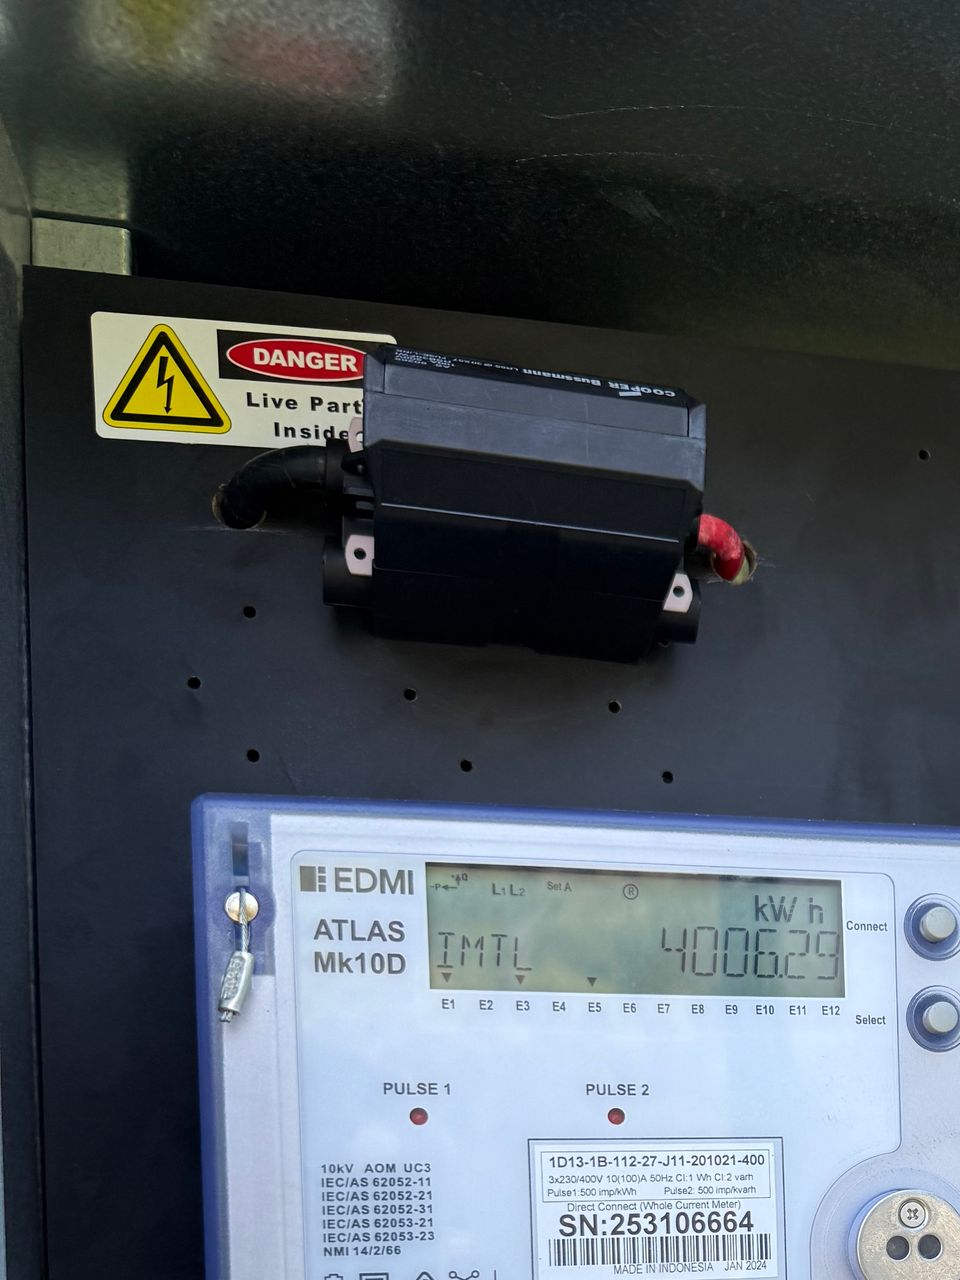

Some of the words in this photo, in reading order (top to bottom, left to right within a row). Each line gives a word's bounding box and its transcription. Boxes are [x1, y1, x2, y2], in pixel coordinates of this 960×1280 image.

[253, 347, 359, 373] DANGER
[522, 368, 601, 387] Bussmann
[608, 381, 677, 398] COOPER
[246, 391, 298, 410] Live
[273, 421, 349, 441] Inside
[334, 867, 414, 895] EDMI
[313, 918, 406, 942] ATLAS
[846, 920, 888, 932] Connect
[662, 925, 841, 981] 4006.29
[314, 951, 406, 975] Mk10D
[441, 998, 456, 1010] E1
[479, 999, 493, 1011] E2
[516, 1000, 530, 1012] E3
[552, 1000, 566, 1012] E4
[588, 1001, 602, 1013] E5
[623, 1002, 637, 1014] E6
[657, 1003, 670, 1014] E7
[691, 1003, 705, 1015] E8
[725, 1004, 738, 1015] E9
[755, 1004, 775, 1016] E10
[789, 1005, 807, 1016] E11
[821, 1005, 841, 1017] E12
[855, 1014, 886, 1026] Select
[383, 1082, 439, 1096] PULSE
[444, 1082, 451, 1095] 1
[586, 1083, 637, 1096] PULSE
[641, 1083, 650, 1096] 2
[321, 1163, 354, 1174] 10kV
[364, 1163, 397, 1174] AOM
[403, 1162, 432, 1174] UC3
[549, 1154, 765, 1168] 1D13-1B-112-27-J11-201021-400
[321, 1177, 369, 1188] IEC/AS
[372, 1176, 431, 1187] 62052-11
[548, 1174, 603, 1184] 3x230/400V
[607, 1174, 648, 1184] 10(100)A
[650, 1173, 673, 1183] 50Hz
[696, 1173, 711, 1182] Wh
[321, 1191, 369, 1202] IEC/AS
[373, 1190, 433, 1201] 62052-21
[698, 1186, 714, 1195] 500
[322, 1205, 370, 1216] IEC/AS
[374, 1204, 433, 1215] 62052-31
[567, 1203, 595, 1212] Direct
[597, 1202, 637, 1212] Connect
[639, 1201, 673, 1211] (Whole
[675, 1201, 709, 1210] Current
[712, 1200, 741, 1210] Meter)
[322, 1219, 371, 1229] IEC/AS
[374, 1218, 433, 1228] 62053-21
[559, 1210, 754, 1237] SN:253106664
[323, 1232, 371, 1243] IEC/AS
[374, 1231, 435, 1242] 62053-23
[323, 1246, 349, 1257] NMI
[353, 1245, 402, 1256] 14/2/66
[613, 1264, 643, 1275] MADE
[646, 1264, 657, 1274] IN
[659, 1262, 714, 1274] INDONESIA
[724, 1261, 743, 1271] JAN
[745, 1260, 767, 1271] 2024
